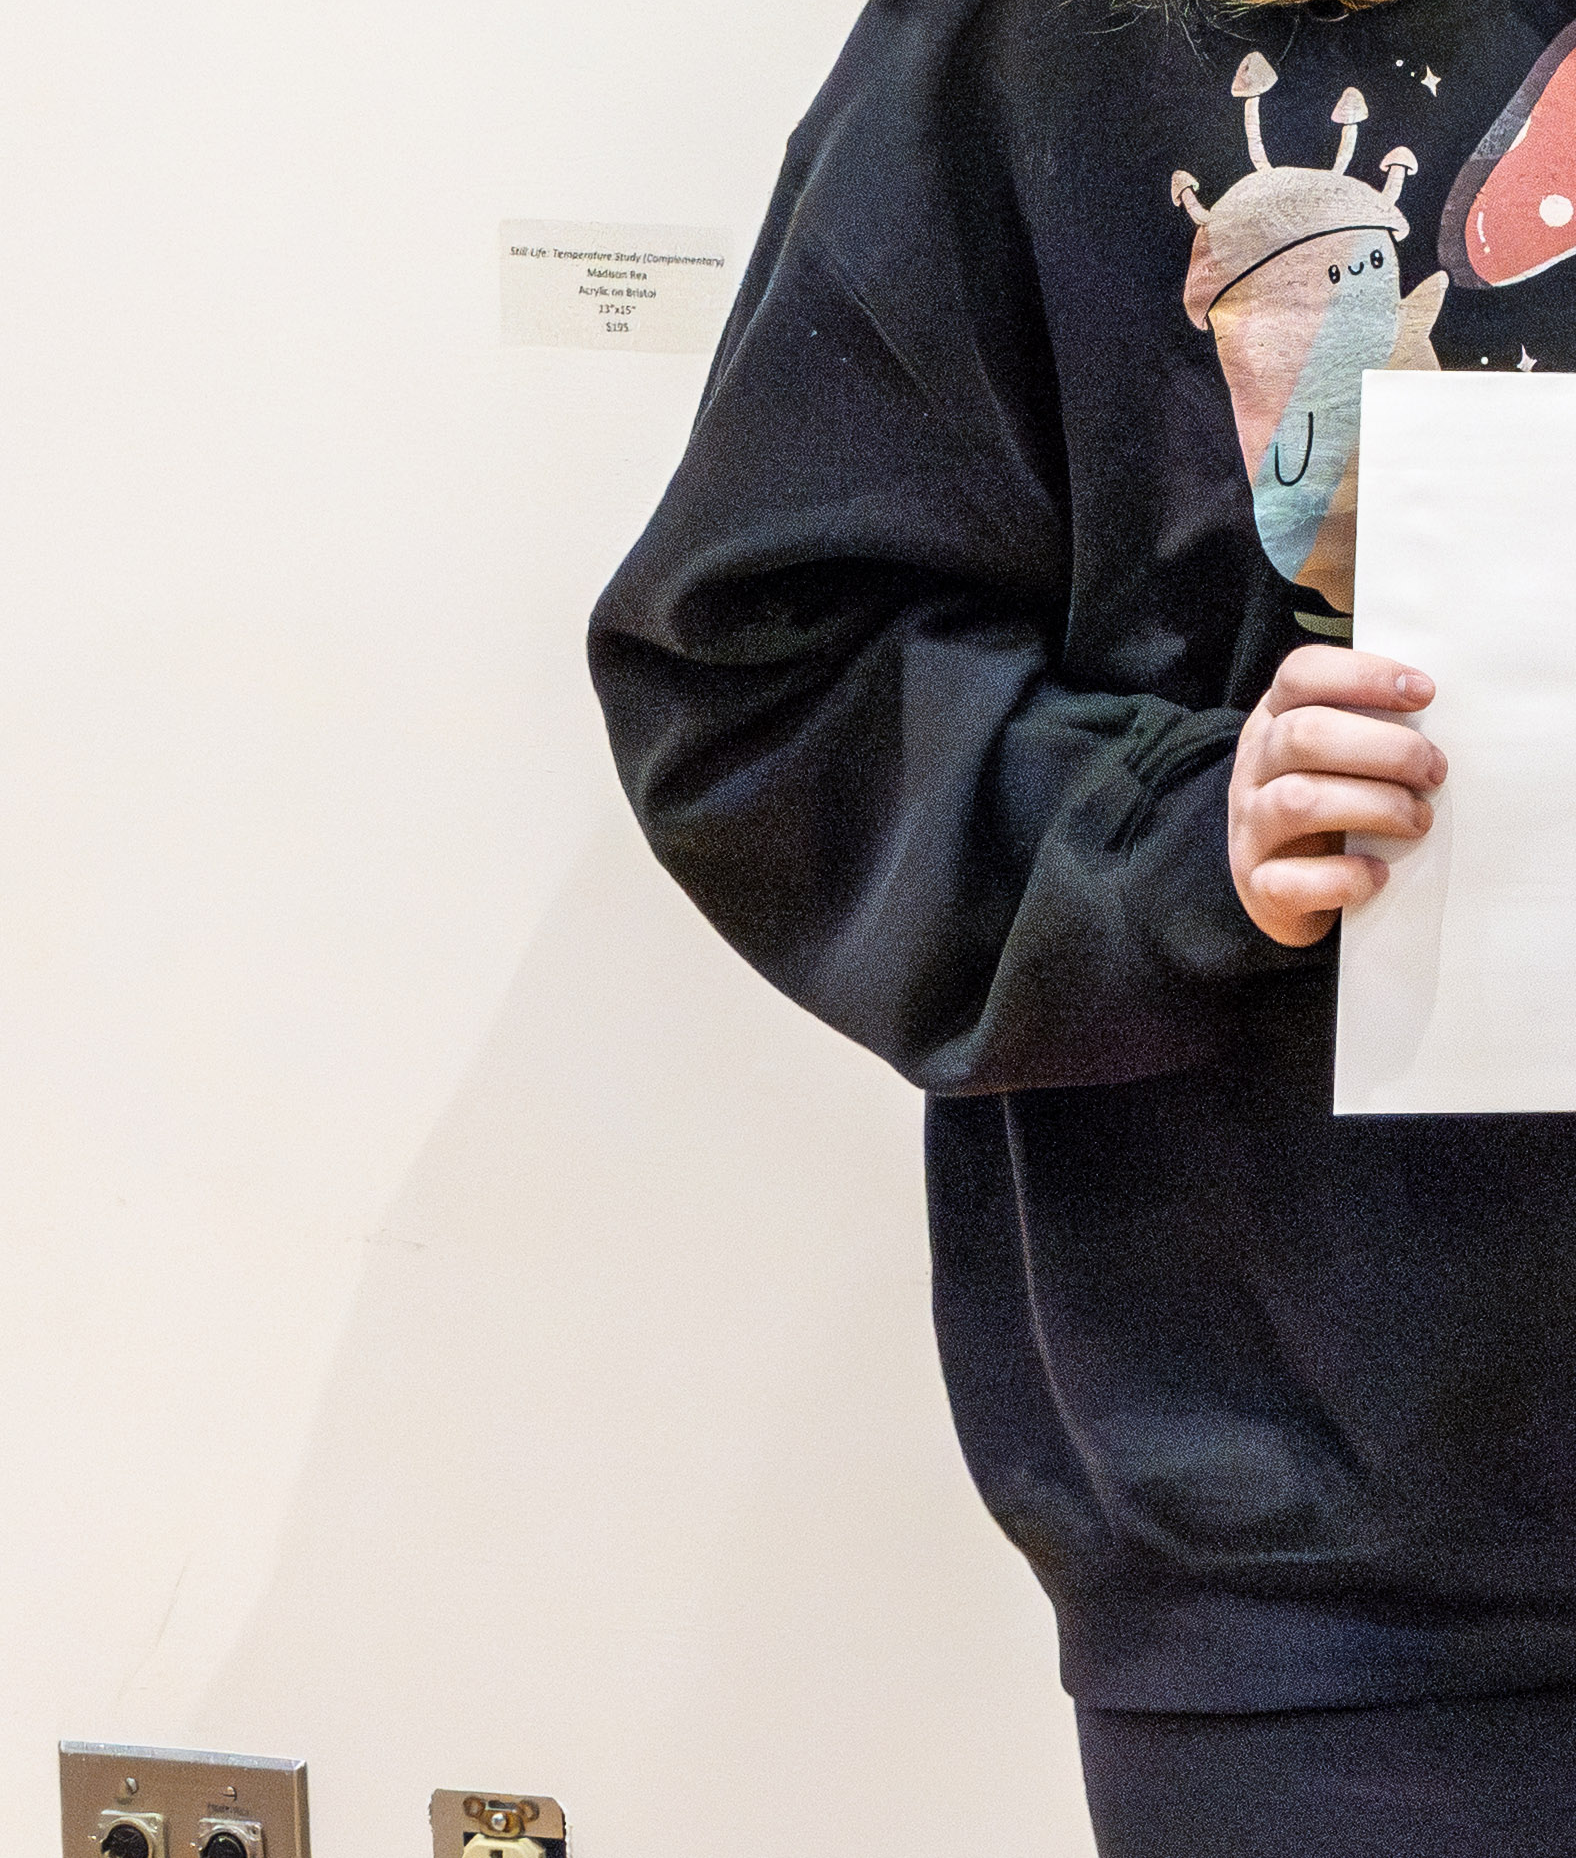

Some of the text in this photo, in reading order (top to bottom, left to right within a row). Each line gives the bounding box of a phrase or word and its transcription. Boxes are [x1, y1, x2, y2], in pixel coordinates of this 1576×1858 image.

[509, 246, 528, 257] Still
[552, 248, 612, 261] Temperature
[614, 252, 641, 263] Study
[642, 252, 725, 268] (Complementary)
[587, 268, 627, 279] Madison
[579, 285, 657, 299] Acrylic on Bristol
